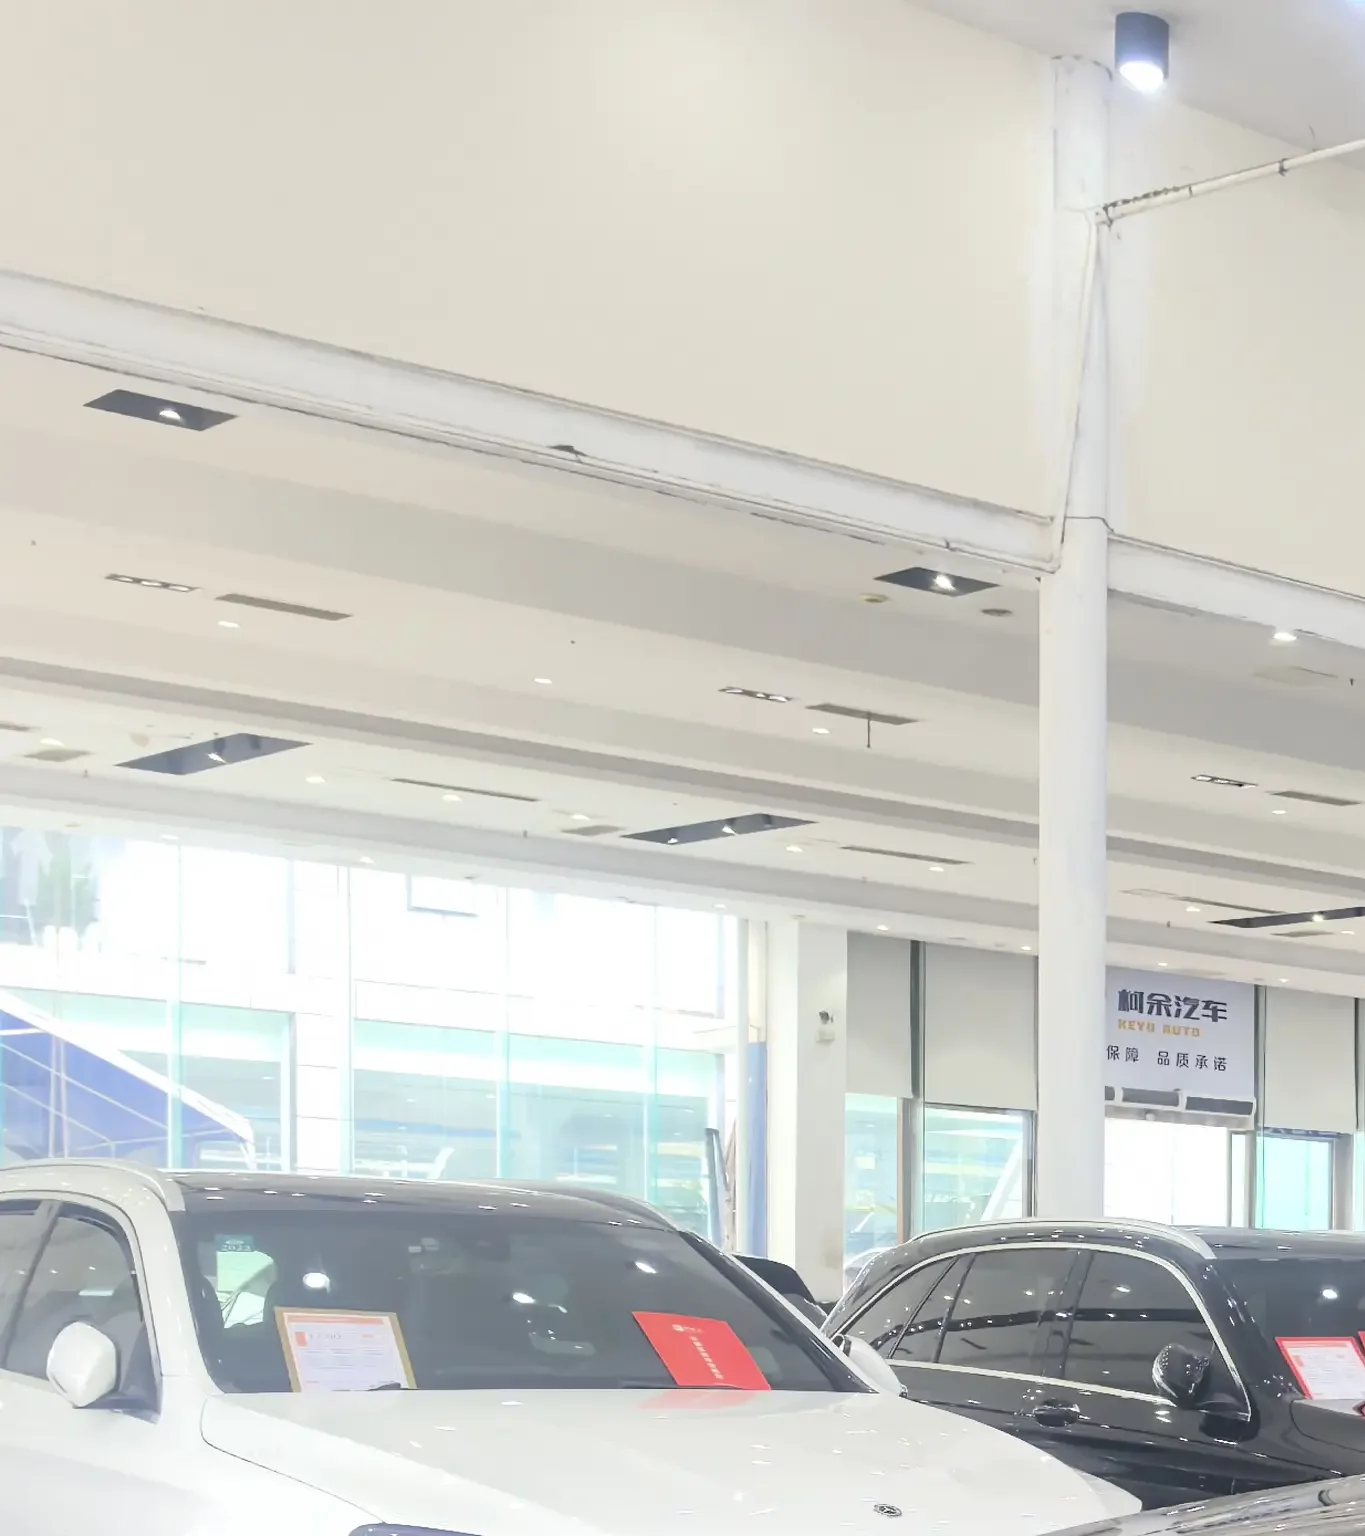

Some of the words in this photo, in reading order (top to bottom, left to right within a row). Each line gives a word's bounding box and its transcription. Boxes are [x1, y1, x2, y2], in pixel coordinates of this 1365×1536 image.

[1118, 989, 1228, 1022] 柯余汽车
[1118, 1019, 1155, 1033] KEYU
[1163, 1024, 1201, 1037] AUTO
[1107, 1045, 1139, 1062] 保障
[1157, 1050, 1228, 1071] 品质承诺
